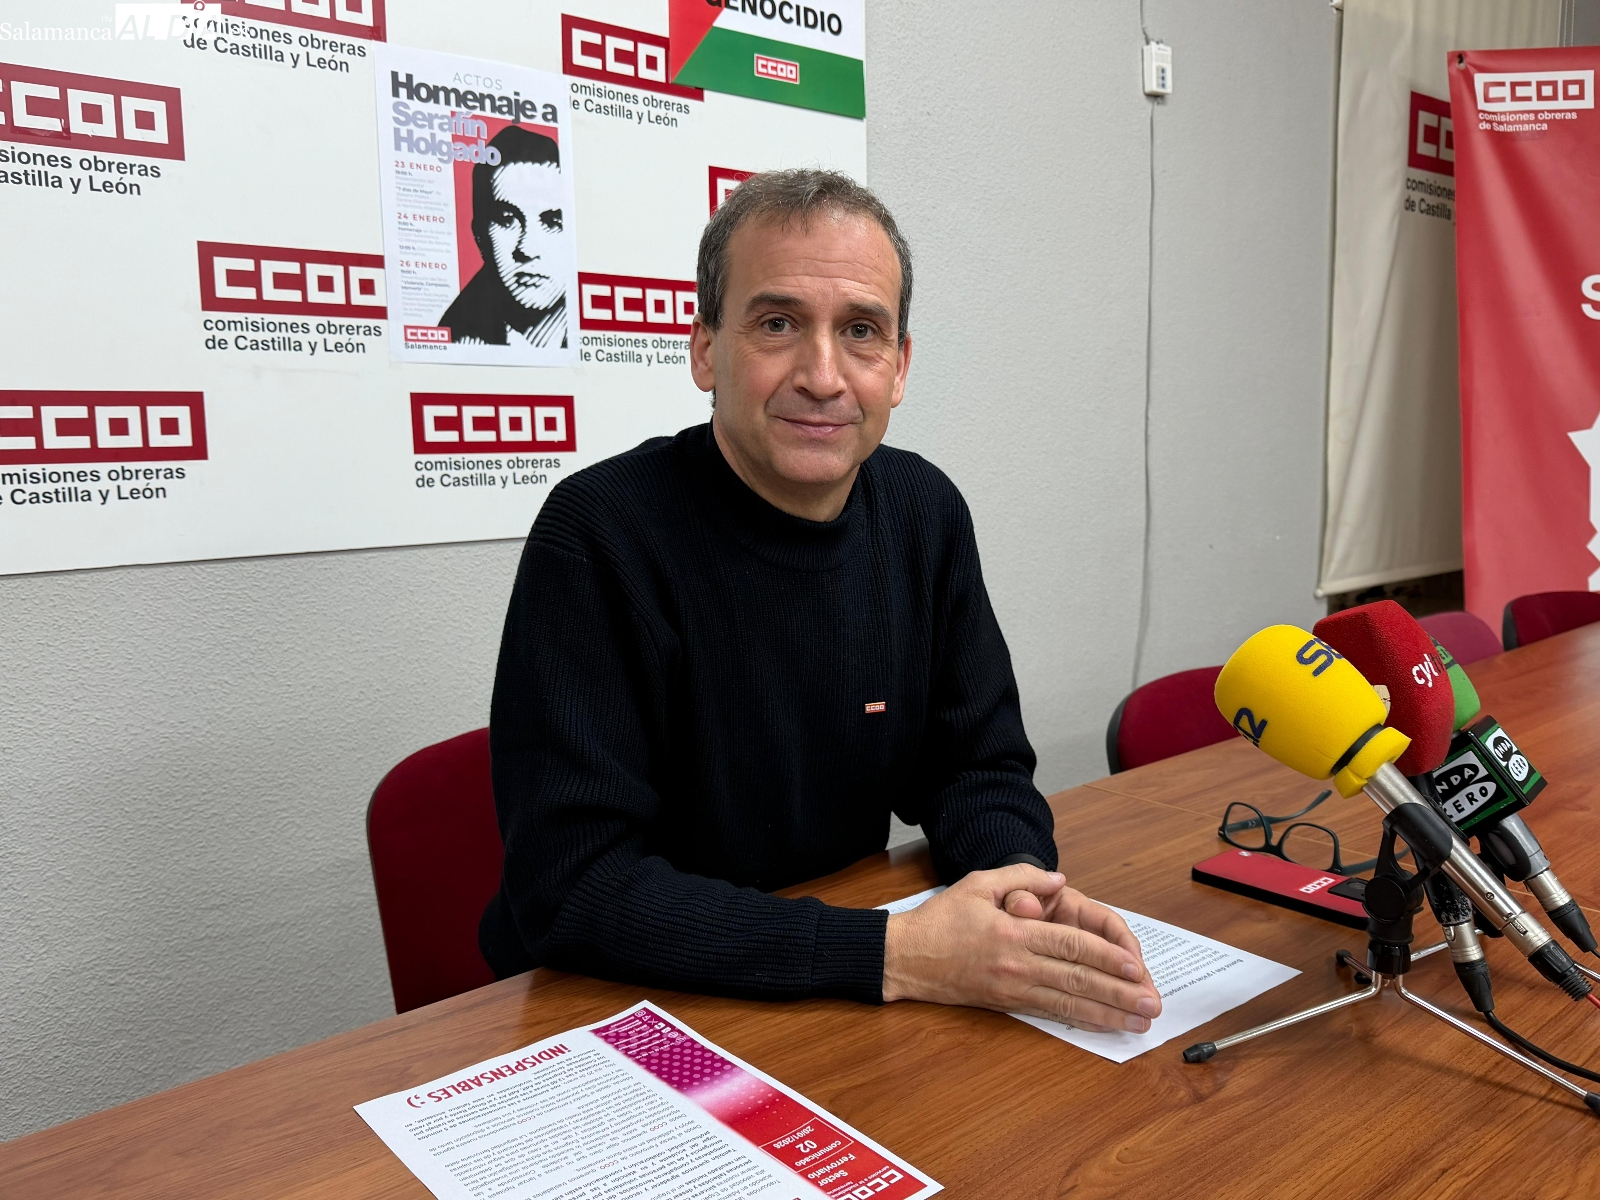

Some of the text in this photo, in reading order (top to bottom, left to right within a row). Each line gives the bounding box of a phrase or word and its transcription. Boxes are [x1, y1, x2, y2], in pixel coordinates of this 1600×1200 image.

[182, 33, 350, 73] de Castilla y León
[299, 33, 367, 57] obreras
[571, 27, 667, 84] CCO
[757, 58, 797, 80] CCOO
[452, 72, 503, 91] ACTOS
[1483, 79, 1586, 104] CCOO
[390, 70, 559, 124] Homenaje a
[570, 82, 690, 115] omisiones obreras
[0, 79, 169, 145] COO
[391, 100, 488, 139] Serafín
[570, 96, 679, 128] e Castilla y León
[1478, 110, 1578, 122] comisiones obreras
[1416, 110, 1454, 163] CC
[1478, 121, 1548, 133] de Salamanca
[393, 126, 503, 166] Holgado
[79, 155, 162, 178] obreras
[394, 160, 406, 170] 23
[409, 162, 443, 173] ENERO
[69, 177, 82, 194] y
[89, 174, 142, 196] León
[397, 212, 409, 221] 24
[412, 213, 446, 224] ENERO
[1404, 195, 1452, 221] de Castilla
[399, 260, 448, 271] 26 ENERO
[213, 256, 387, 307] CCOO
[203, 316, 382, 337] comisiones obreras
[406, 328, 449, 342] CCOO
[204, 335, 366, 356] de Castilla y León
[404, 343, 448, 351] Salamanca
[595, 350, 643, 363] Castilla
[646, 353, 653, 367] y
[656, 351, 687, 366] León
[422, 404, 567, 443] CCOO
[107, 465, 186, 482] obreras
[414, 456, 562, 472] comisiones obreras
[415, 471, 548, 489] de Castilla y León
[10, 482, 168, 506] Castilla y León
[1435, 767, 1476, 795] NDA
[772, 1125, 815, 1151] 20/01/2026
[795, 1139, 818, 1154] 02
[794, 1140, 842, 1167] comunicado
[807, 1153, 857, 1179] Ferroviario
[818, 1169, 849, 1187] Sector
